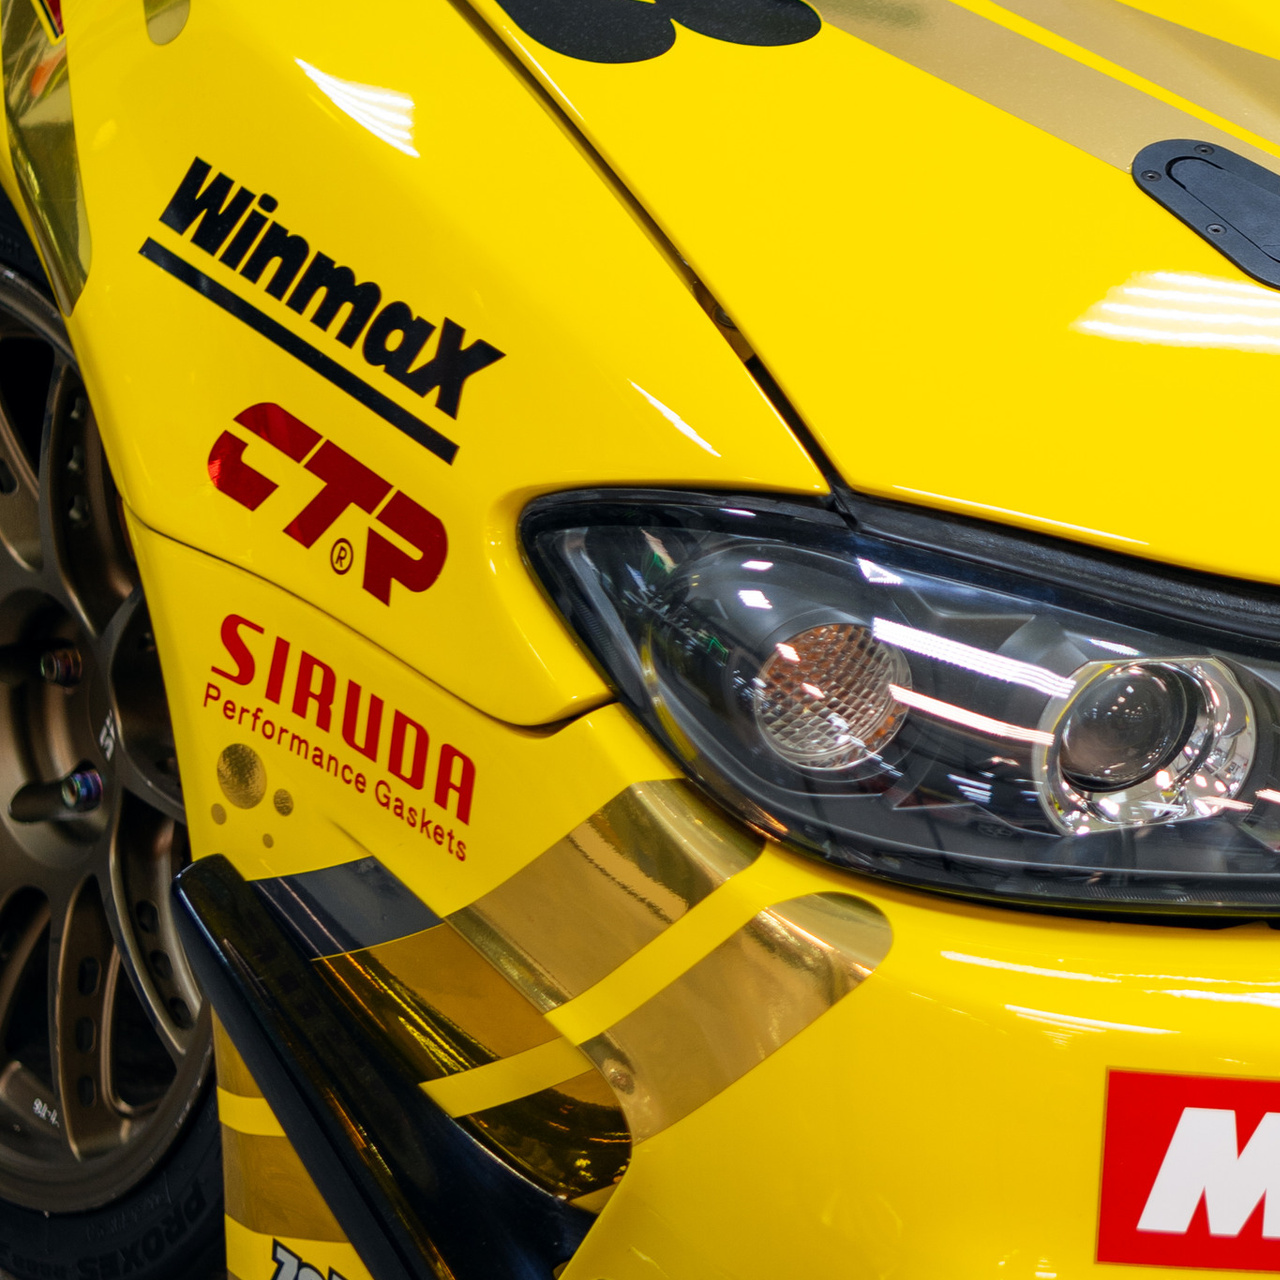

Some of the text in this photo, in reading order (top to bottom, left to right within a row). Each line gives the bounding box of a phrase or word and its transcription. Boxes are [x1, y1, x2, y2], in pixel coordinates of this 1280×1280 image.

[207, 401, 449, 608] CTP
[203, 681, 368, 794] Performance
[374, 779, 469, 865] Gaskets
[210, 612, 477, 826] SIRUDA
